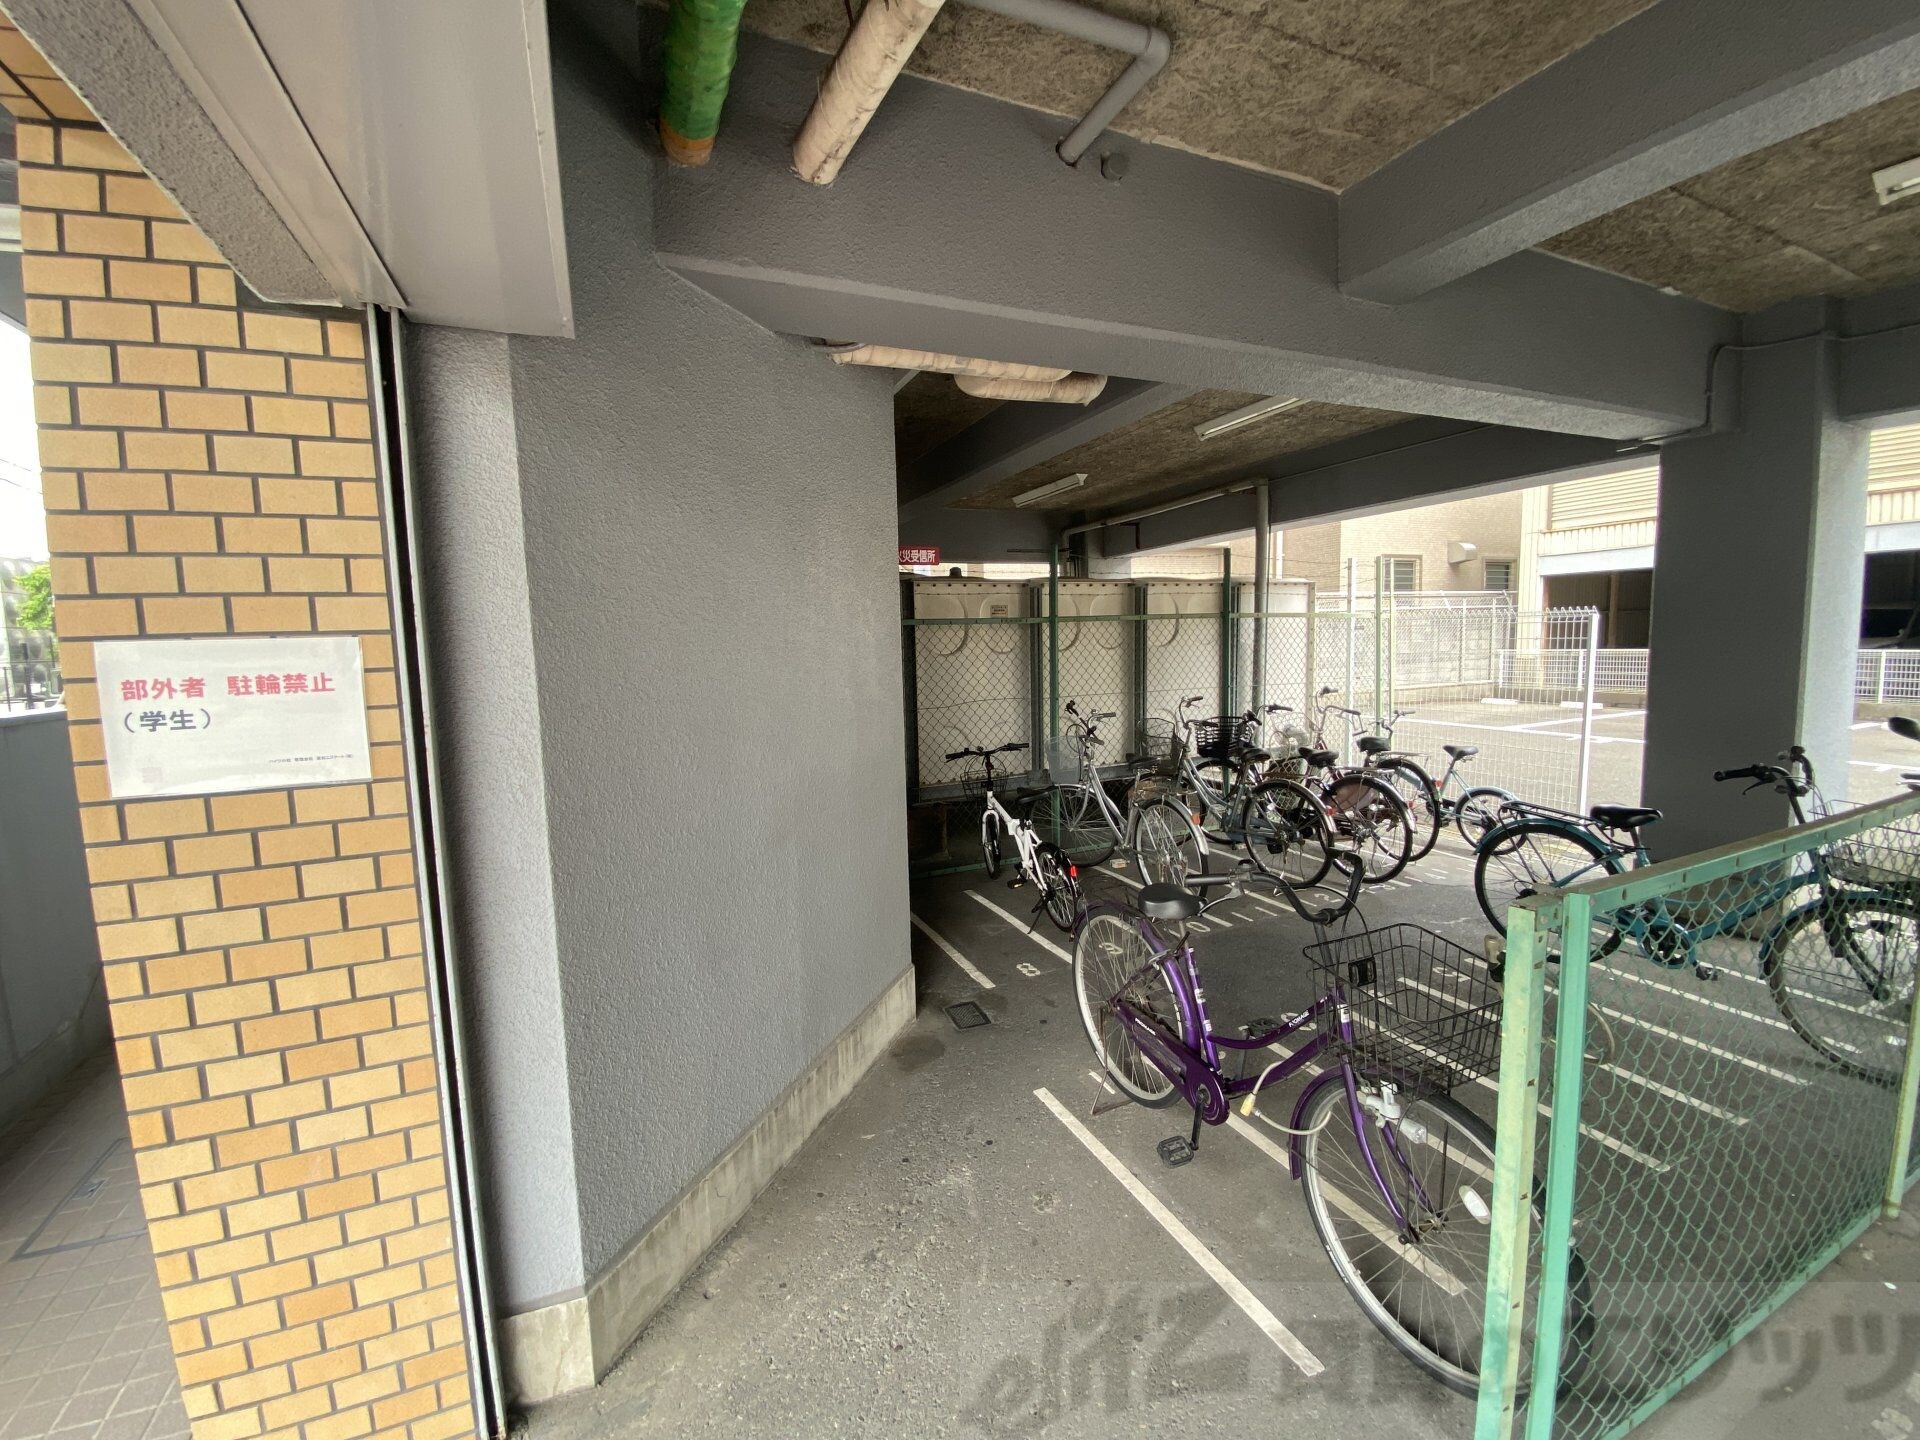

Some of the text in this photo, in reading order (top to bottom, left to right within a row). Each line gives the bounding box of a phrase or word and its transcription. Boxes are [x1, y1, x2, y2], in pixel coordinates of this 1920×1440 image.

[120, 672, 336, 701] 部外者 駐輪禁止
[1016, 962, 1041, 977] 8
